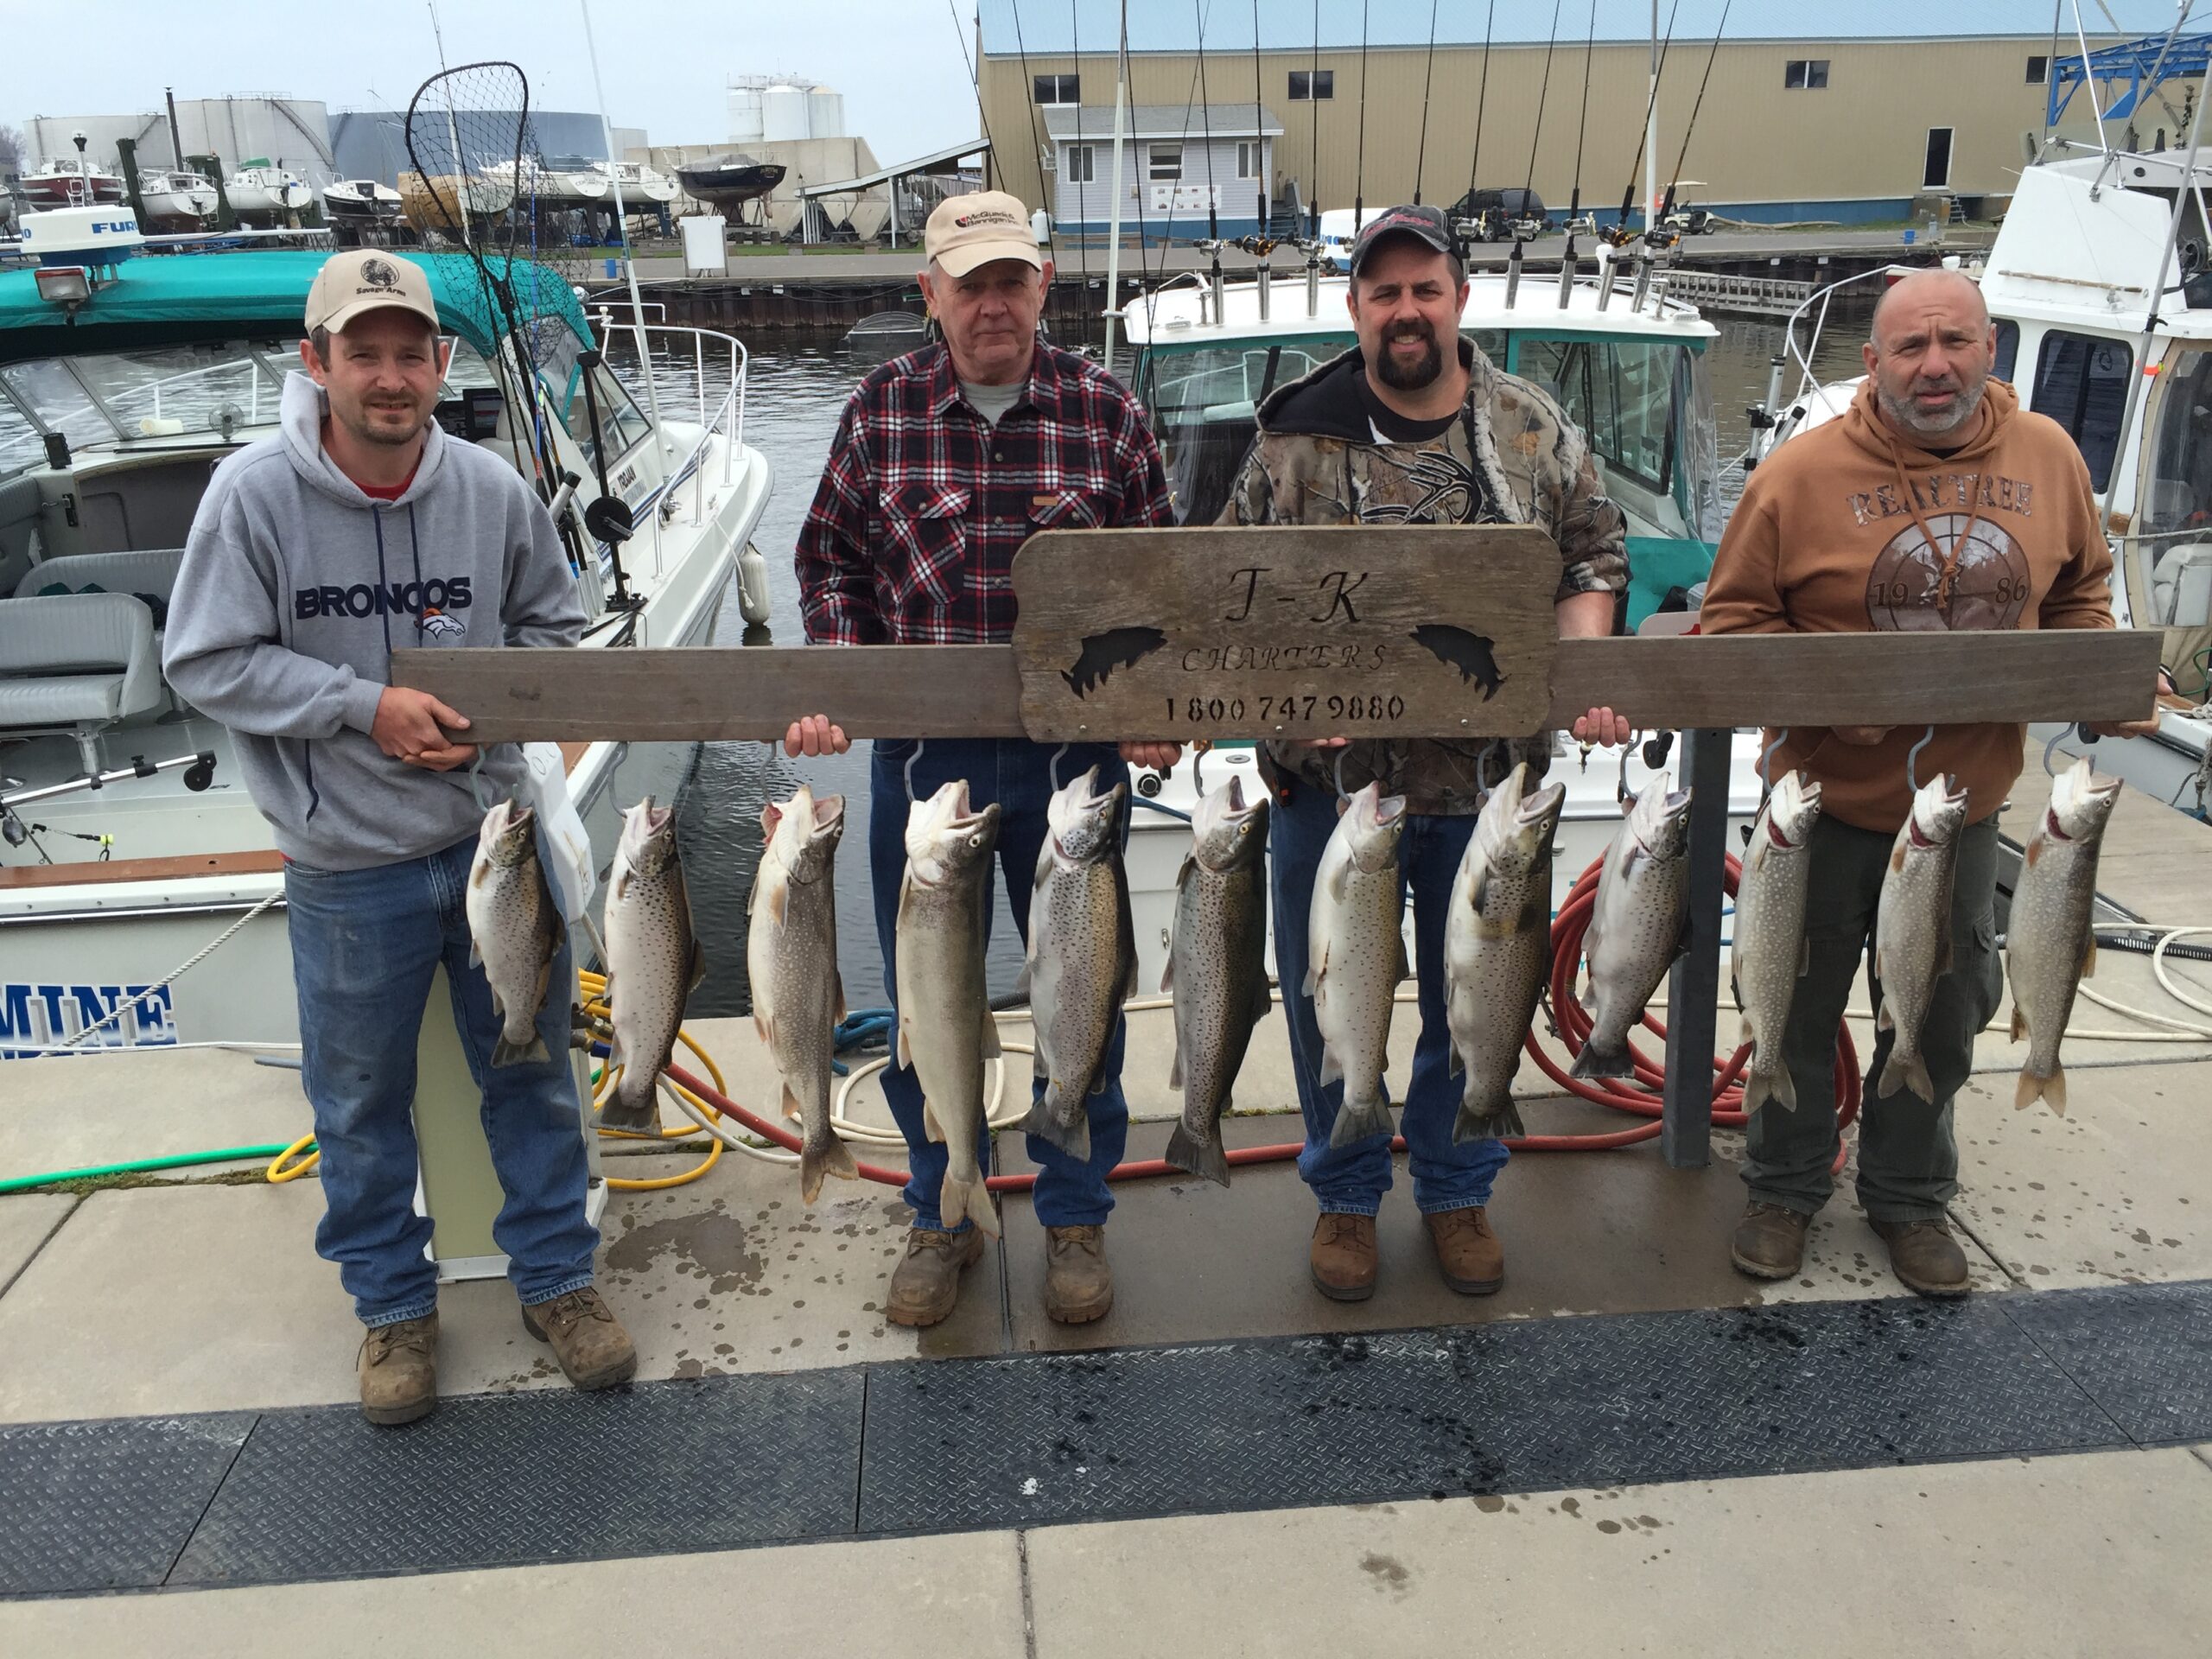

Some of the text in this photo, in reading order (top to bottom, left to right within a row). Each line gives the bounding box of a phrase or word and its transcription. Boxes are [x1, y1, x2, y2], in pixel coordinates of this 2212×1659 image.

[1846, 474, 2034, 529] REALTREE
[296, 576, 473, 620] BRONCOS
[1872, 575, 2027, 606] 19 86
[1181, 644, 1387, 672] CHARTERS
